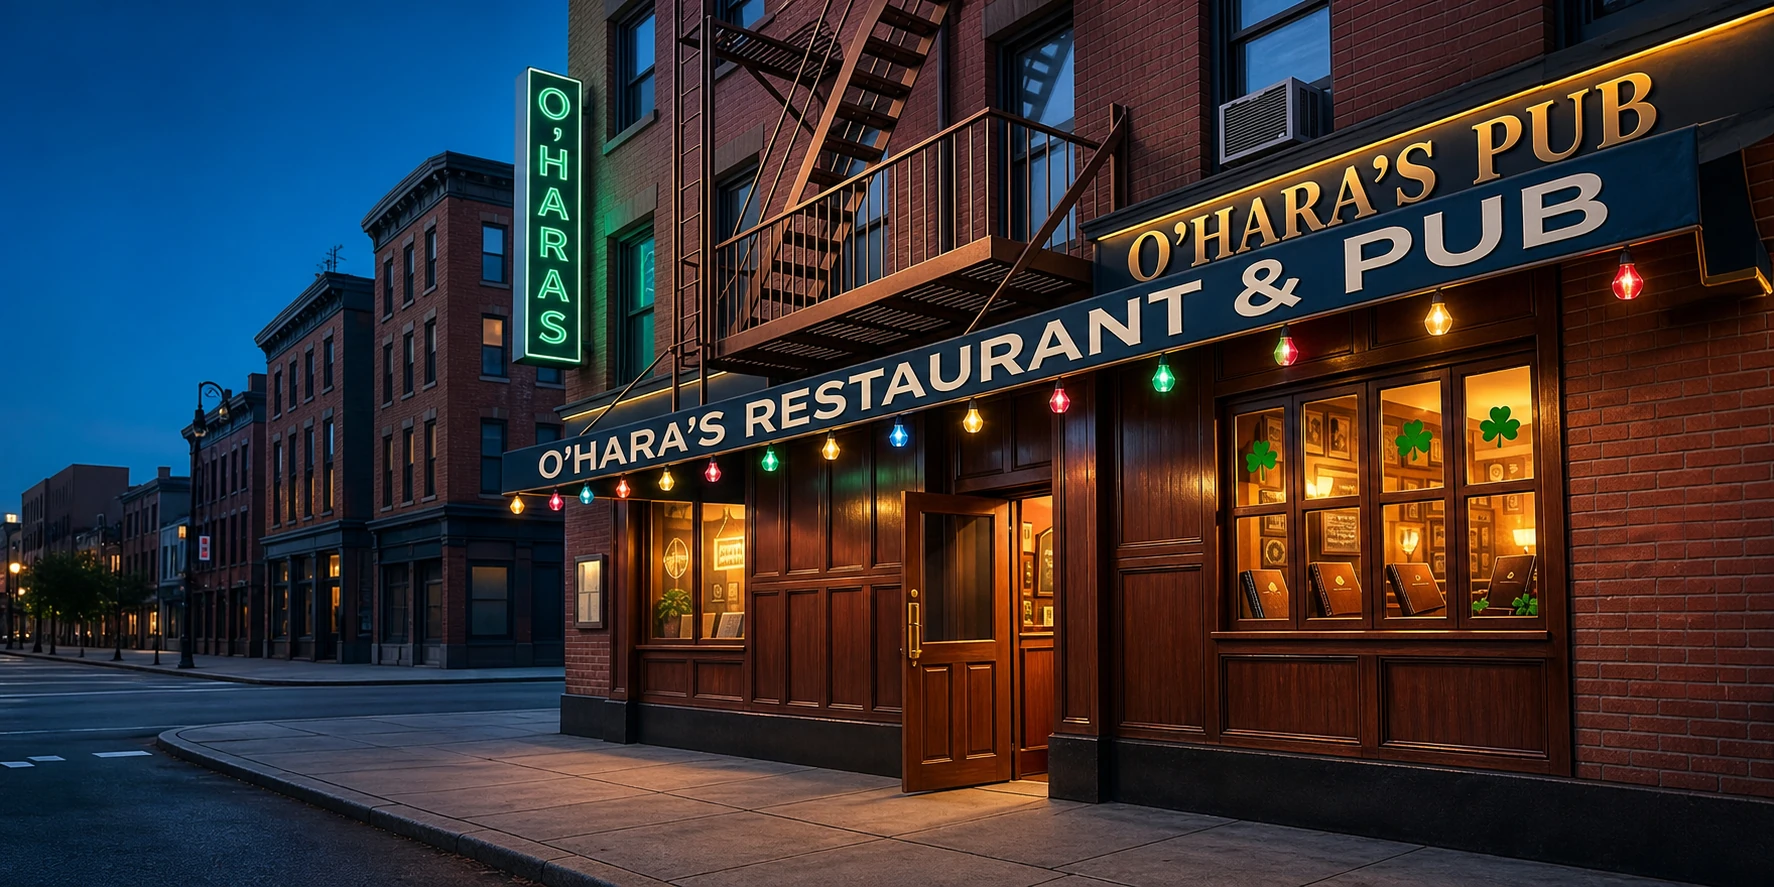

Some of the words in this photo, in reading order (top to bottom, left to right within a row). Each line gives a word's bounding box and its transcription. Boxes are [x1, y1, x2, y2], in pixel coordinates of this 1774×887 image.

[537, 87, 570, 345] O'HARAS
[1128, 141, 1437, 282] O'HARA'S
[1471, 72, 1657, 185] PUB
[538, 411, 726, 479] O'HARA'S
[746, 279, 1202, 438] RESTAURANT
[1234, 258, 1301, 317] &
[1343, 172, 1608, 294] PUB
